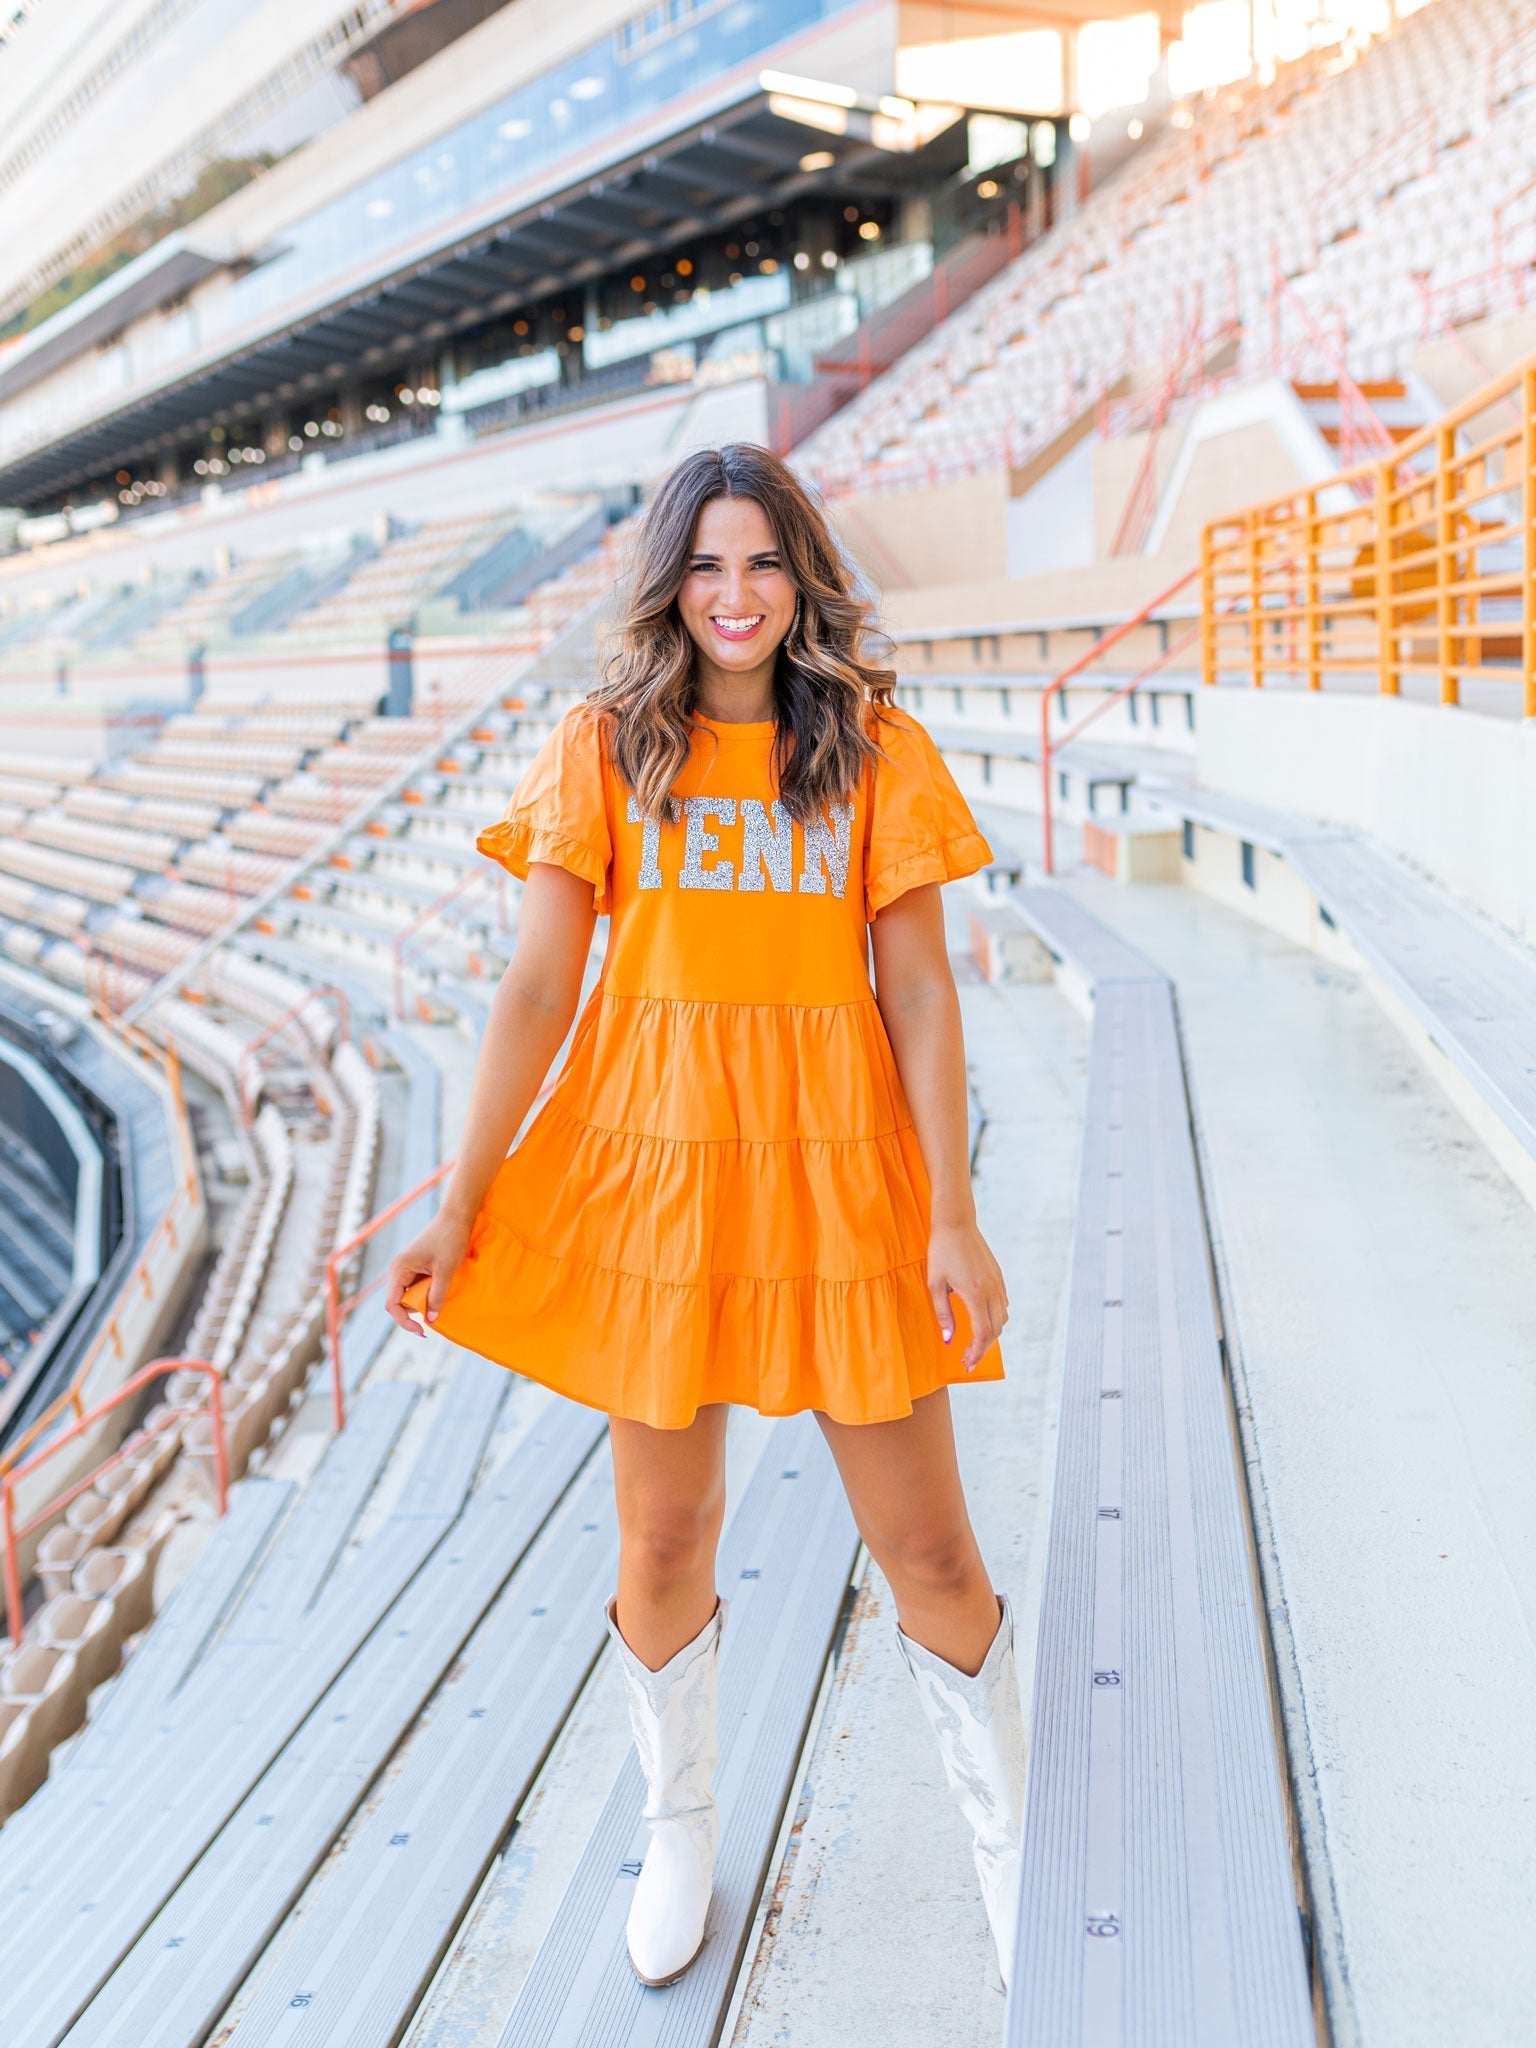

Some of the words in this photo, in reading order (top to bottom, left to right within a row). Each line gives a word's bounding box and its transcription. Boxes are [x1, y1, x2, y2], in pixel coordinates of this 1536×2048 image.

[627, 795, 854, 899] TENN
[1098, 1508, 1120, 1519] 17
[1093, 1669, 1120, 1686] 18
[621, 1862, 643, 1877] 17
[1087, 1914, 1119, 1938] 19
[290, 1993, 312, 2007] 16
